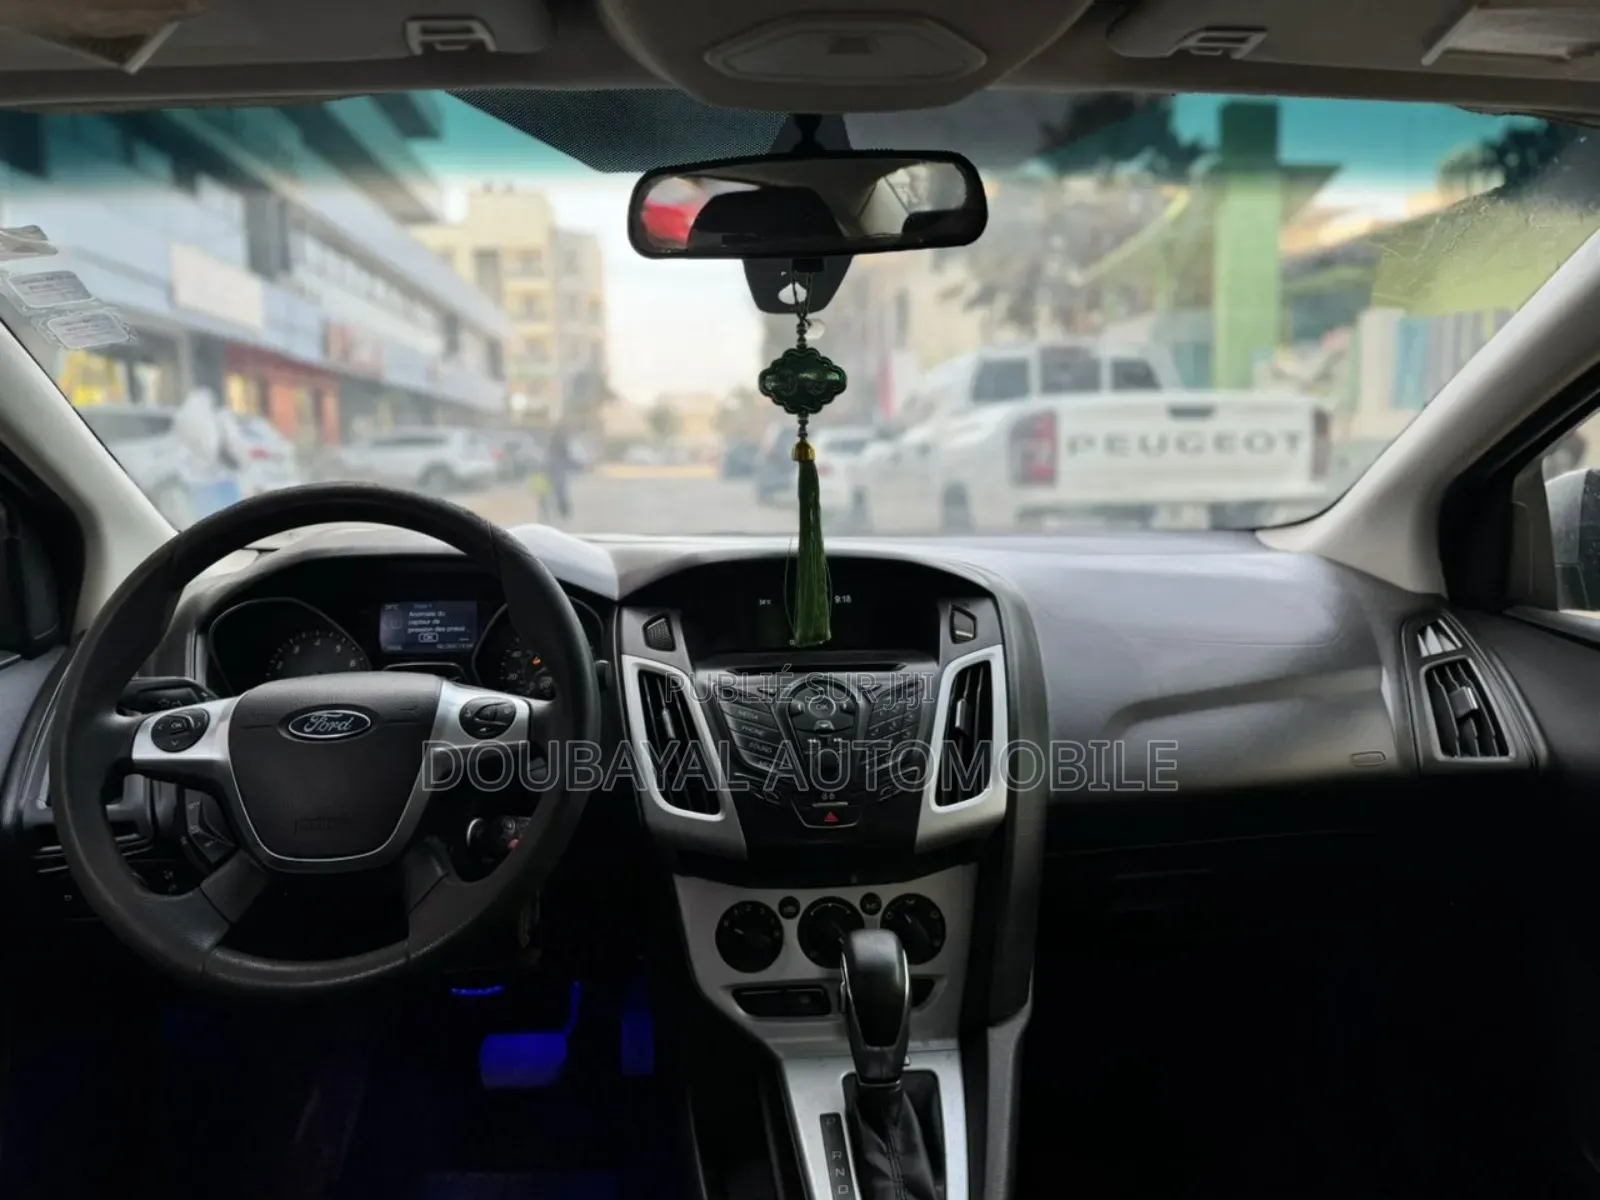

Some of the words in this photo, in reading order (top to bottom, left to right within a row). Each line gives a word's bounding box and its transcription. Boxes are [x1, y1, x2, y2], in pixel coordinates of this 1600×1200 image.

[1066, 430, 1303, 456] PEUGEOT
[835, 595, 852, 604] 9:18
[303, 713, 355, 733] Ford
[832, 1150, 842, 1160] R
[835, 1167, 845, 1177] N
[838, 1184, 849, 1195] D
